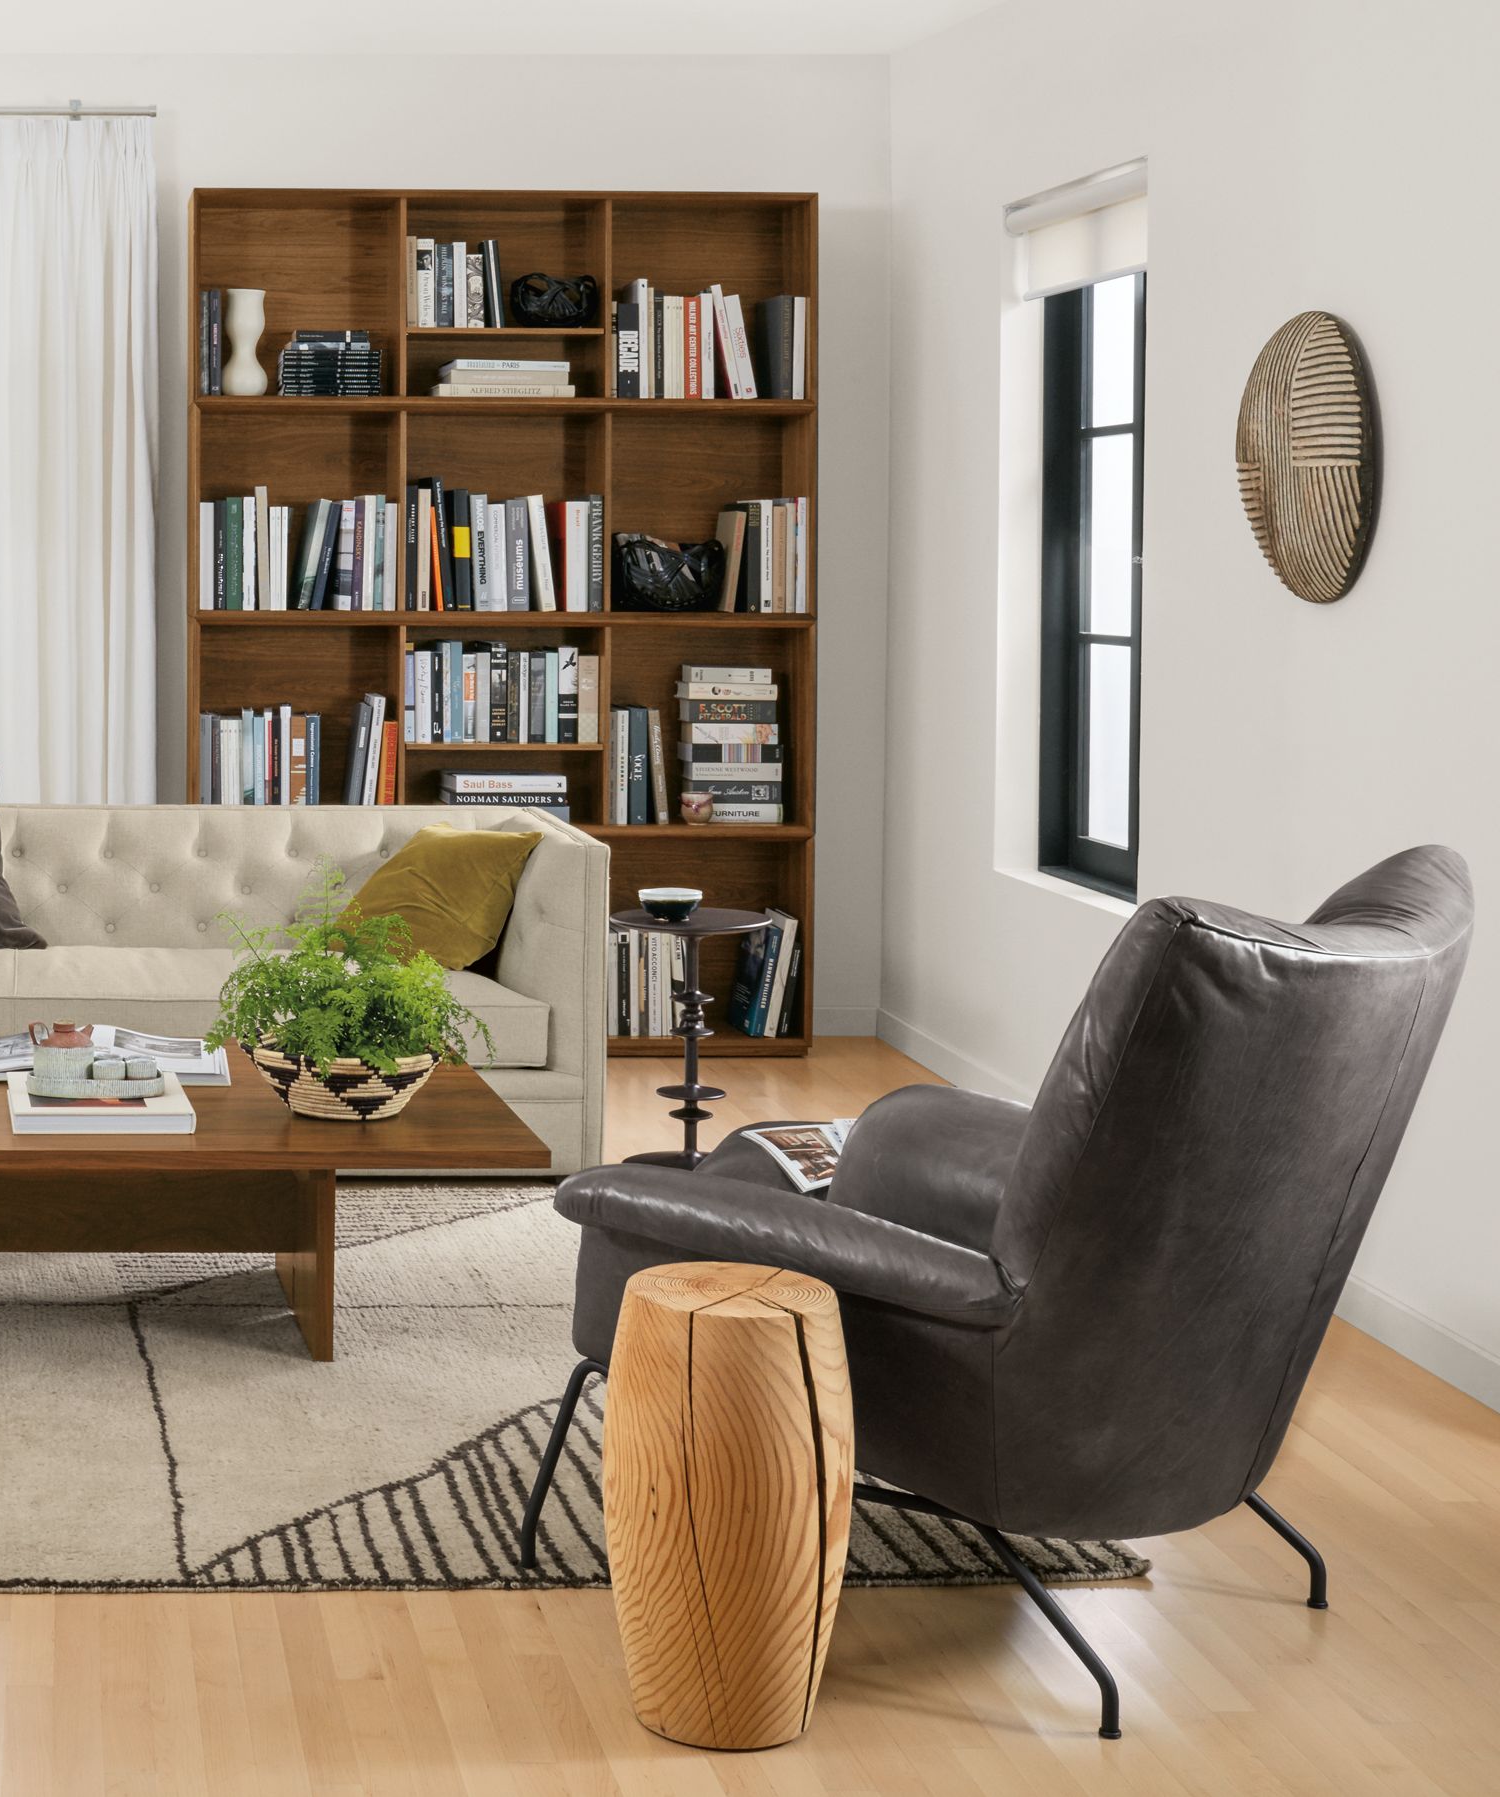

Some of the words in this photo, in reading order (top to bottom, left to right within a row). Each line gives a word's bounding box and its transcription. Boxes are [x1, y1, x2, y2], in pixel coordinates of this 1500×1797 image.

[422, 273, 432, 294] Orson
[689, 301, 697, 323] WALKER
[689, 324, 697, 335] ART
[619, 330, 639, 372] DECADE
[689, 336, 697, 357] CENTER
[735, 327, 747, 359] Sixties
[502, 361, 520, 369] PARIS
[689, 358, 697, 395] COLLECTIONS
[501, 387, 541, 395] STIEGLITZ
[476, 498, 485, 531] MAKOS
[592, 500, 603, 542] FRANK
[355, 521, 363, 561] KANDINSKY
[477, 531, 487, 585] EVERYTHING
[515, 539, 523, 590] museums
[592, 544, 603, 584] GEHRY
[698, 703, 708, 713] F.
[710, 703, 747, 713] SCOTT
[698, 713, 747, 721] FITZGERALD
[633, 754, 646, 781] VOGUE
[463, 779, 485, 789] Saul
[488, 779, 513, 789] Bass
[456, 795, 499, 803] NORMAN
[501, 795, 552, 804] SAUNDERS
[764, 958, 775, 982] HANNAH
[760, 983, 770, 1009] VILLIGER
